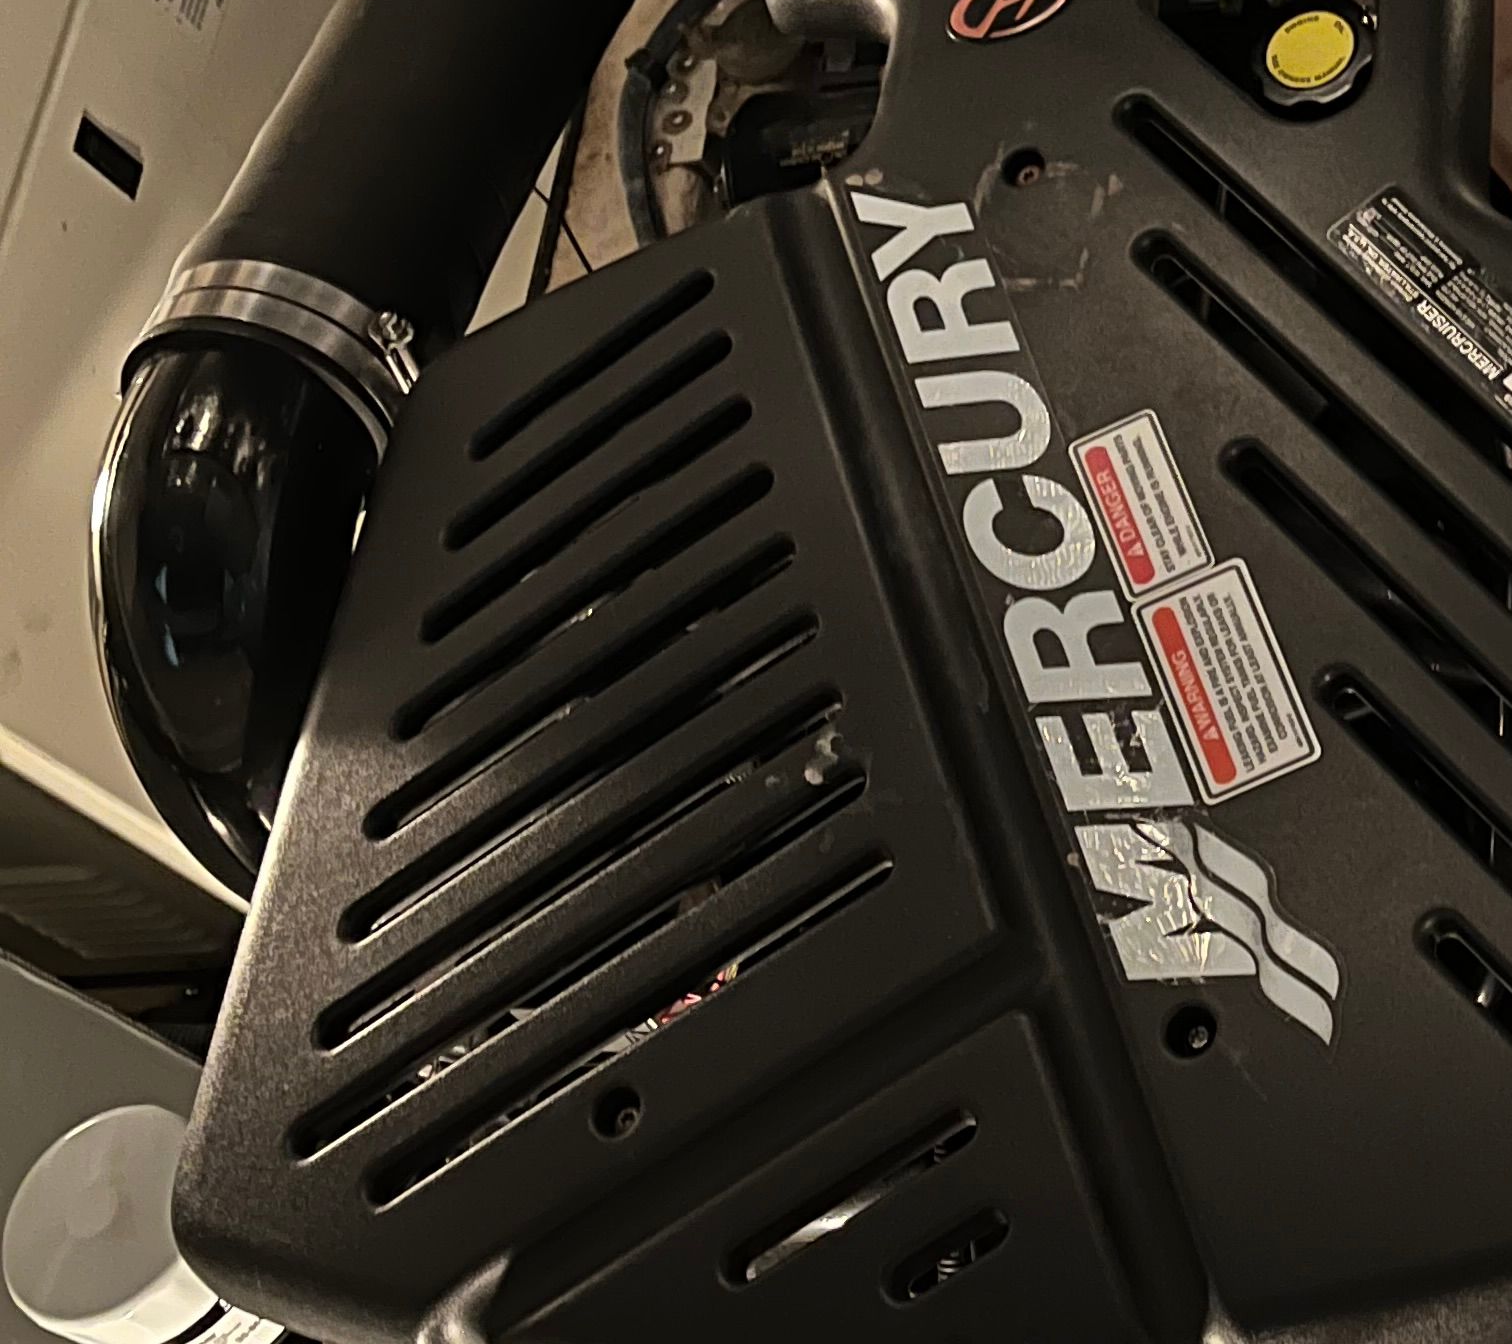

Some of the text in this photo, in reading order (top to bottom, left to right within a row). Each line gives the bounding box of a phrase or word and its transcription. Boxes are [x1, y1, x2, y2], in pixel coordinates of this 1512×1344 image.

[1413, 297, 1502, 382] MERCRUISER
[1111, 433, 1177, 573] STAY CLEAR OF MOVING PARTS
[1149, 479, 1161, 491] IS
[1095, 469, 1137, 543] DANGER
[1152, 490, 1176, 526] ENGINE
[1167, 524, 1188, 557] WHILE
[850, 186, 1258, 982] MERCURY
[1177, 595, 1206, 647] EXPLOSION
[1197, 645, 1214, 668] AND
[1205, 591, 1279, 753] EXAMINE FUEL TANKS FOR LEAKS OR
[1212, 646, 1235, 685] SYSTEM
[1241, 641, 1261, 673] LEAST
[1168, 647, 1215, 730] WARNING
[1205, 666, 1222, 689] FIRE
[1253, 671, 1266, 685] AT
[1217, 695, 1229, 707] IS
[1221, 706, 1240, 732] FUEL
[1228, 683, 1251, 723] INSPECT
[1258, 683, 1289, 740] CORROSION
[1230, 730, 1256, 773] LEAKING
